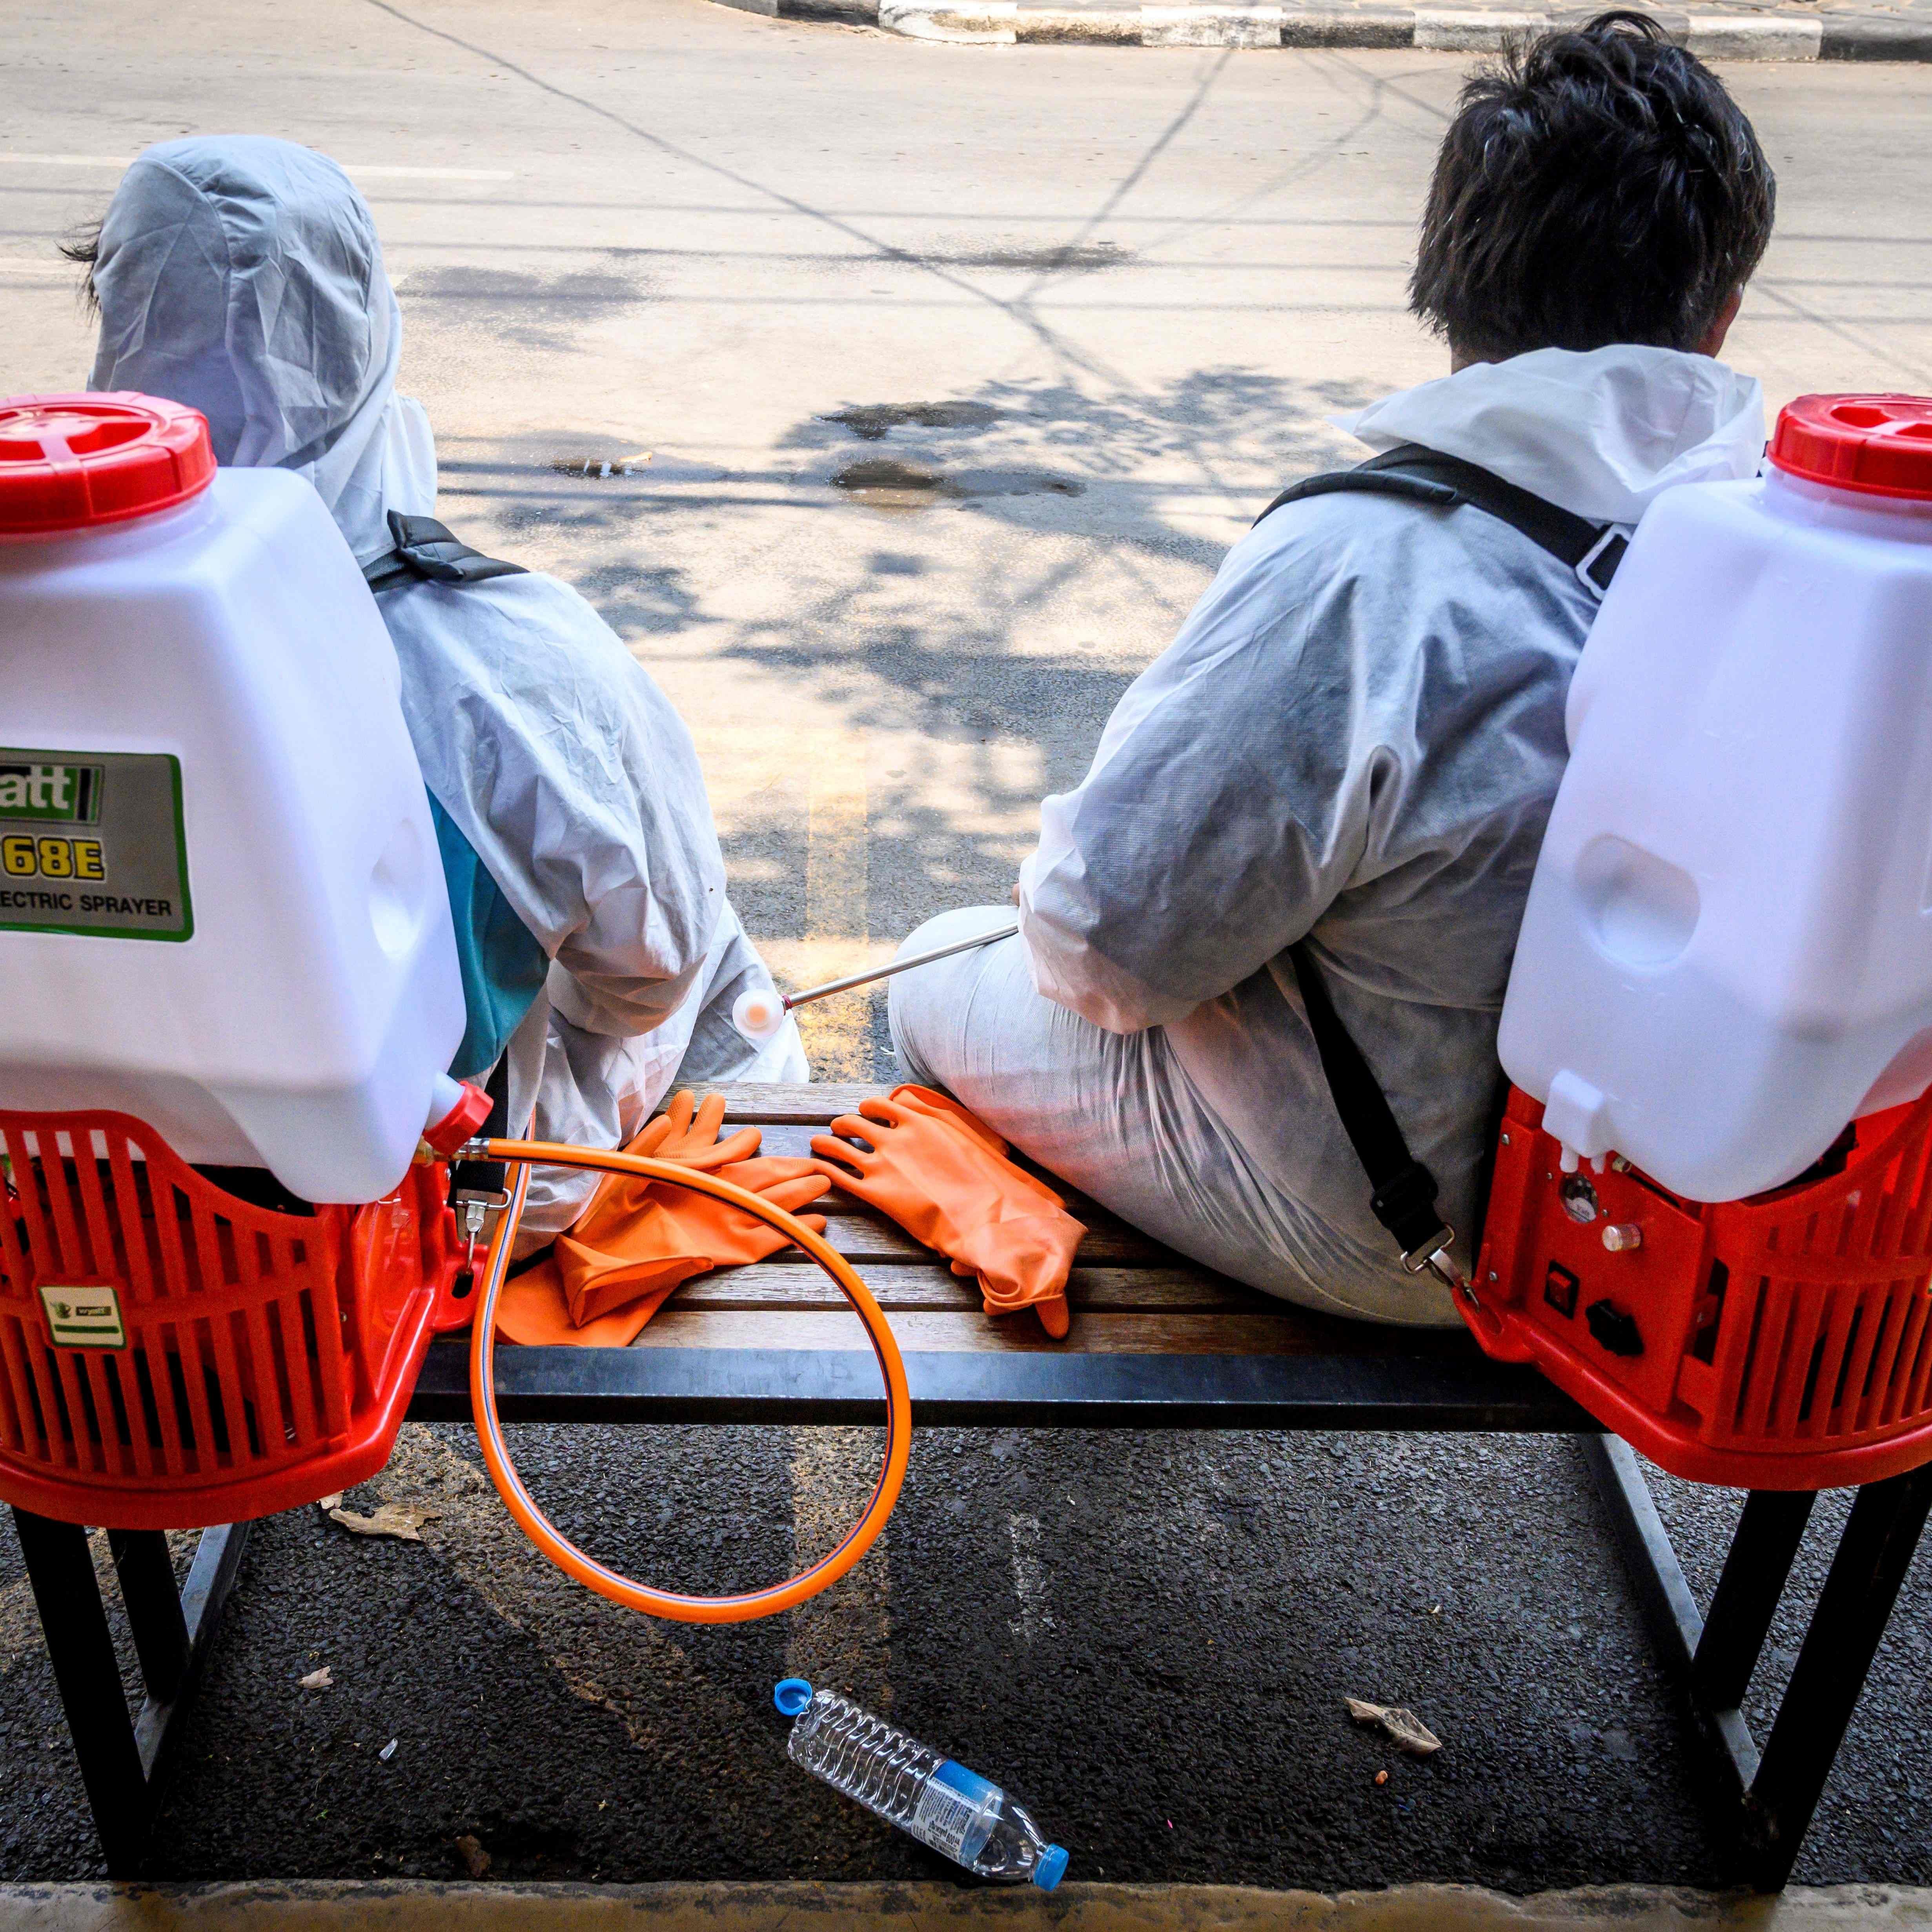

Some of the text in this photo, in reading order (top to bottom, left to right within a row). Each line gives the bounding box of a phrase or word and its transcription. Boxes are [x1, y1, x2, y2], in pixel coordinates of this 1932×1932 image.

[2, 834, 105, 881] 68E
[0, 891, 172, 916] ECTRIC SPRAYER
[946, 1832, 955, 1845] 600
